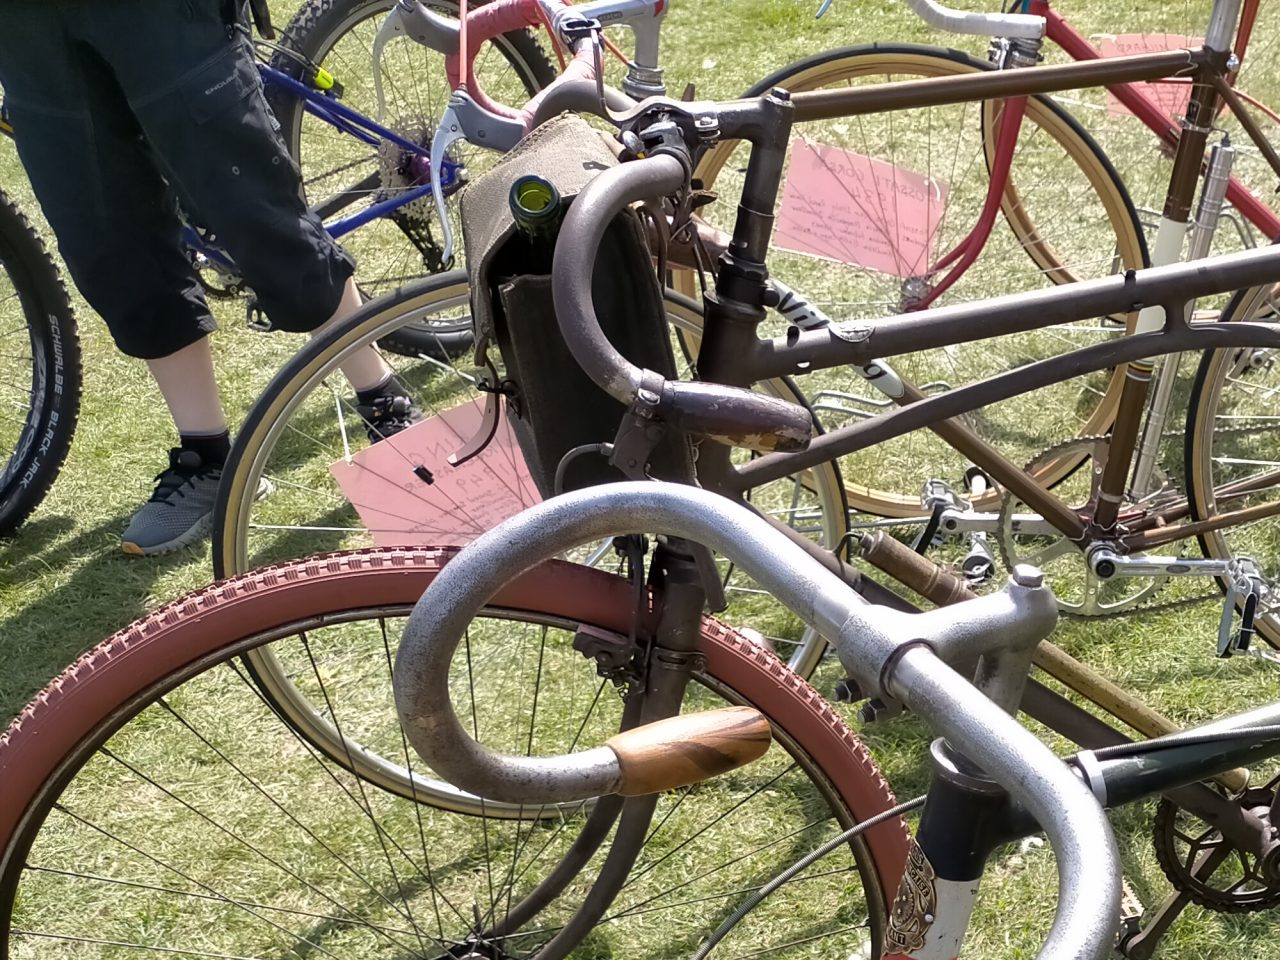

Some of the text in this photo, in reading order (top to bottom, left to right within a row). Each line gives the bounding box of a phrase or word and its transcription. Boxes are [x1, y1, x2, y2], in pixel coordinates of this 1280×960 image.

[20, 313, 64, 489] SCHWALBE BLACK JACK
